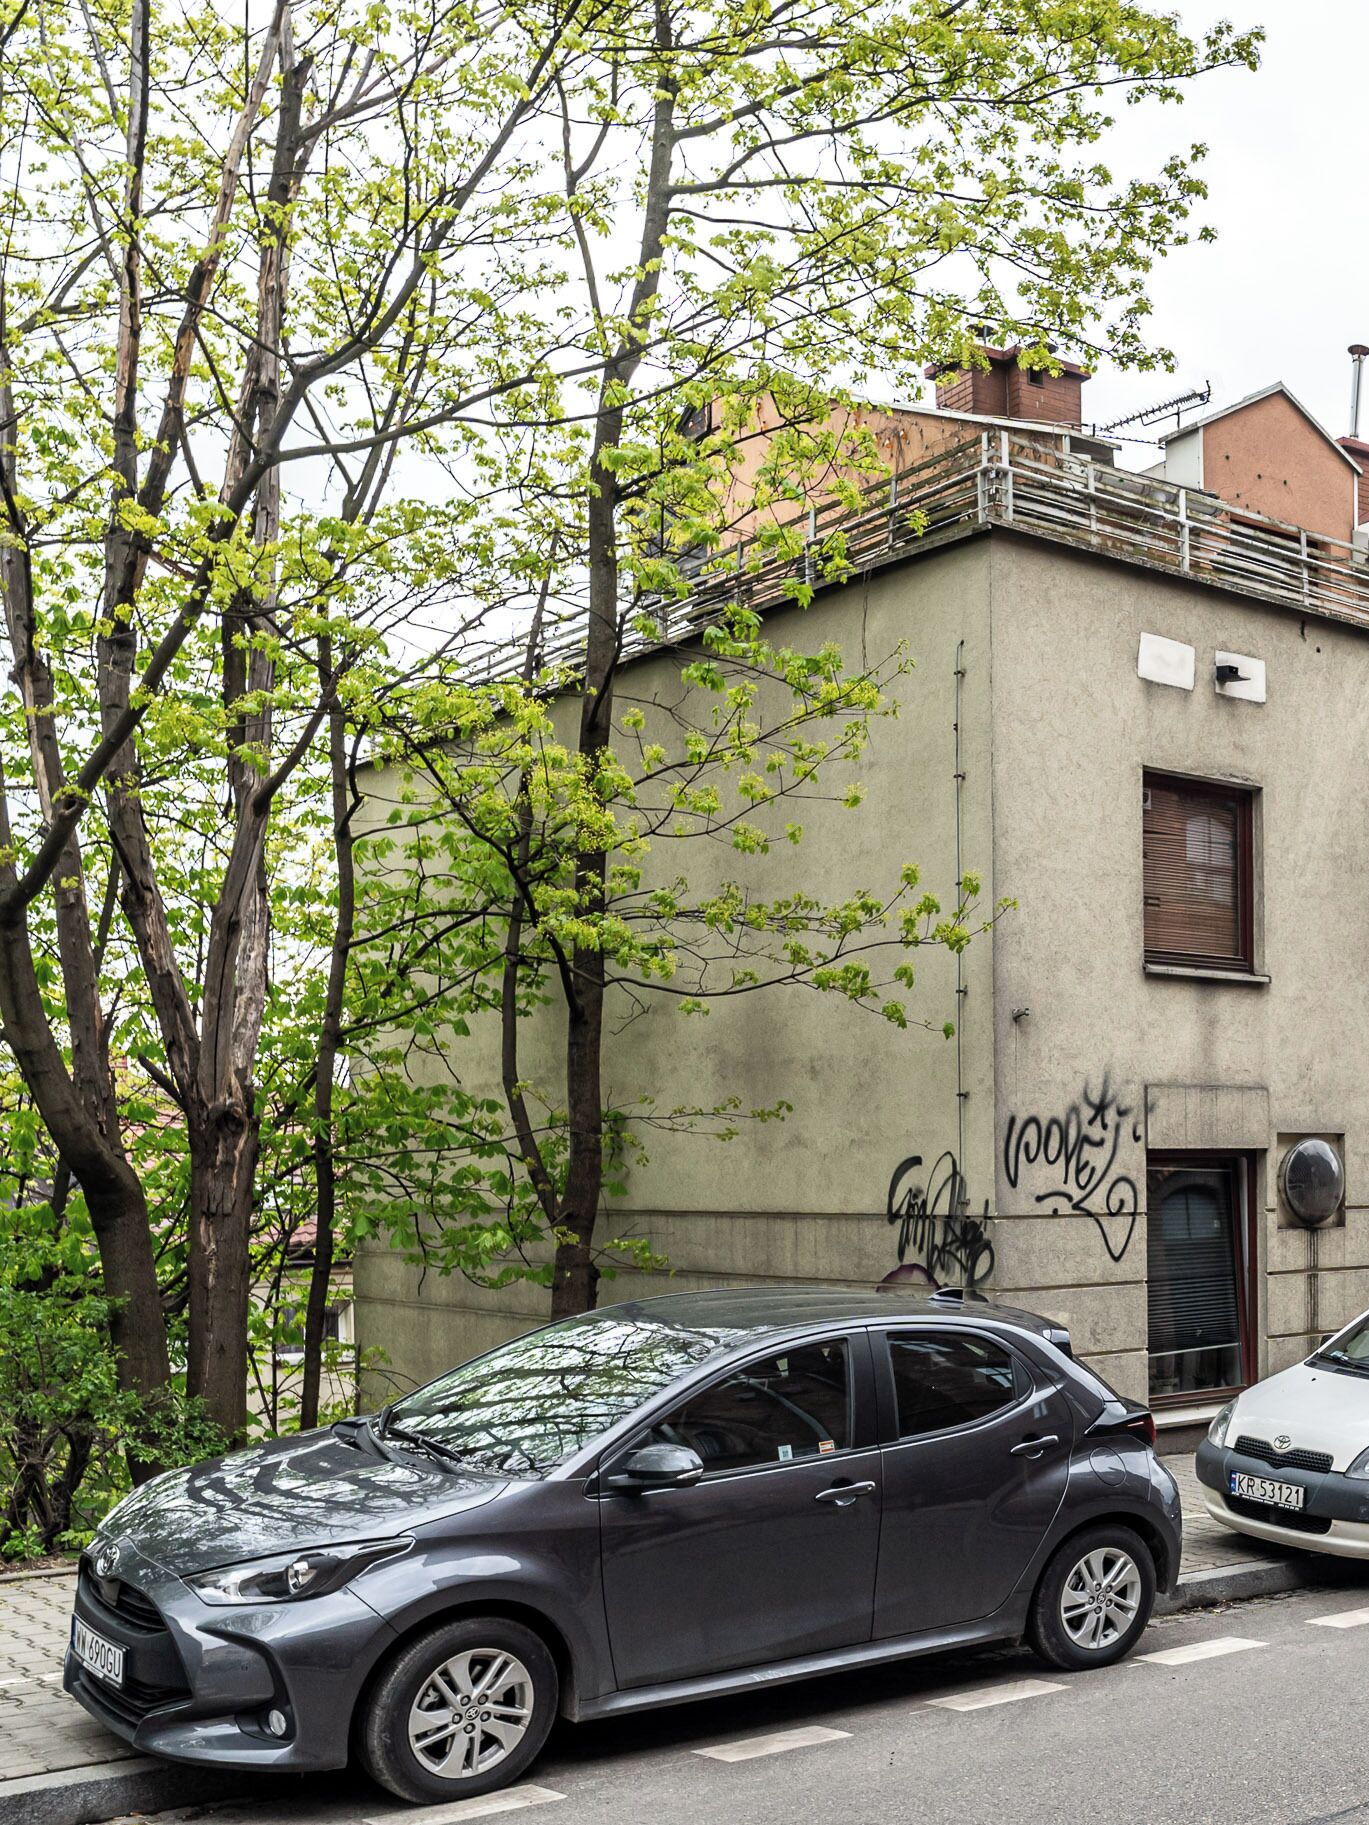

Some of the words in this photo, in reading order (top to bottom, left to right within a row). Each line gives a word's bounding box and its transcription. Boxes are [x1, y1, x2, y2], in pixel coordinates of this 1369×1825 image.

[1237, 1474, 1255, 1495] KR
[1260, 1480, 1300, 1505] 53121
[89, 1636, 121, 1678] 690GU
